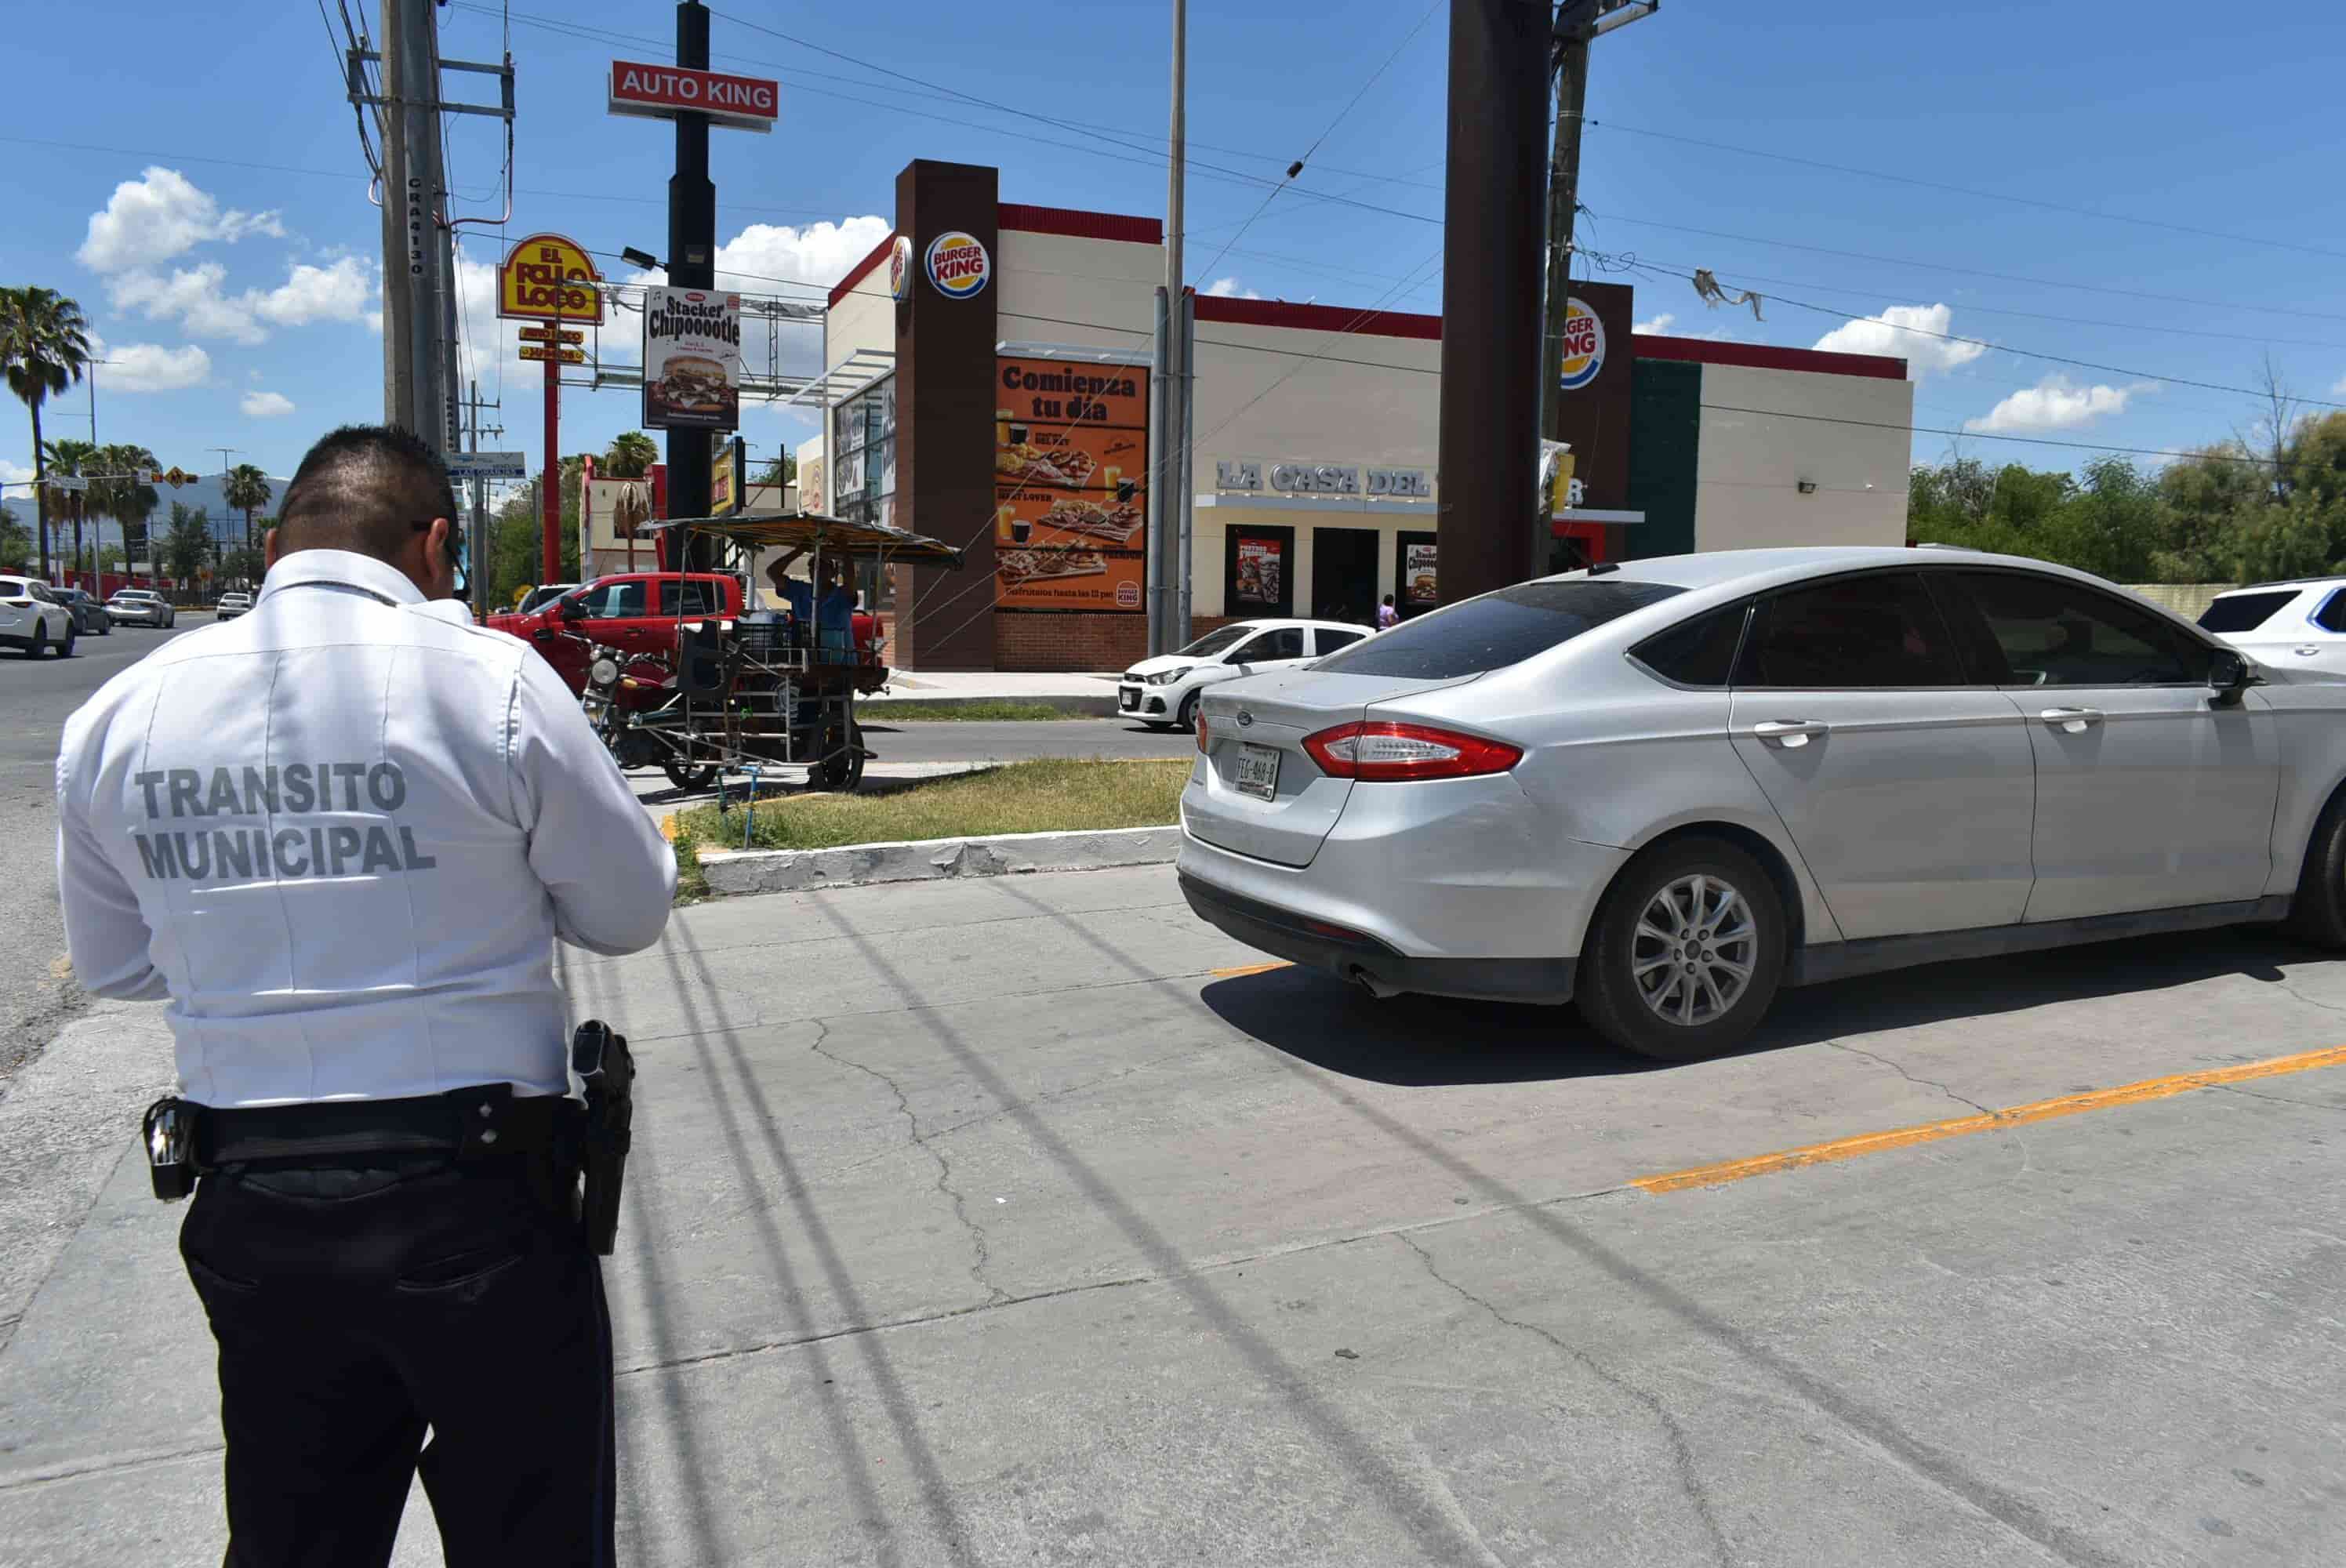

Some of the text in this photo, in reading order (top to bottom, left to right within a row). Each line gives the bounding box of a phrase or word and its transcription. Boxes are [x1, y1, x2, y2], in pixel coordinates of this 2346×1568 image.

[622, 69, 772, 108] AUTO KING
[539, 247, 563, 264] EL
[933, 245, 982, 266] BURGER
[516, 262, 588, 286] POLLO
[935, 256, 984, 281] KING
[516, 285, 586, 310] LOCO
[666, 293, 725, 318] Stacker
[1567, 317, 1594, 334] GER
[1564, 332, 1596, 358] NG
[1002, 365, 1136, 397] Comienza
[1032, 396, 1061, 418] tu
[1217, 461, 1431, 496] LA CASA DEL
[134, 762, 406, 819] TRANSITO
[133, 825, 437, 881] MUNICIPAL
